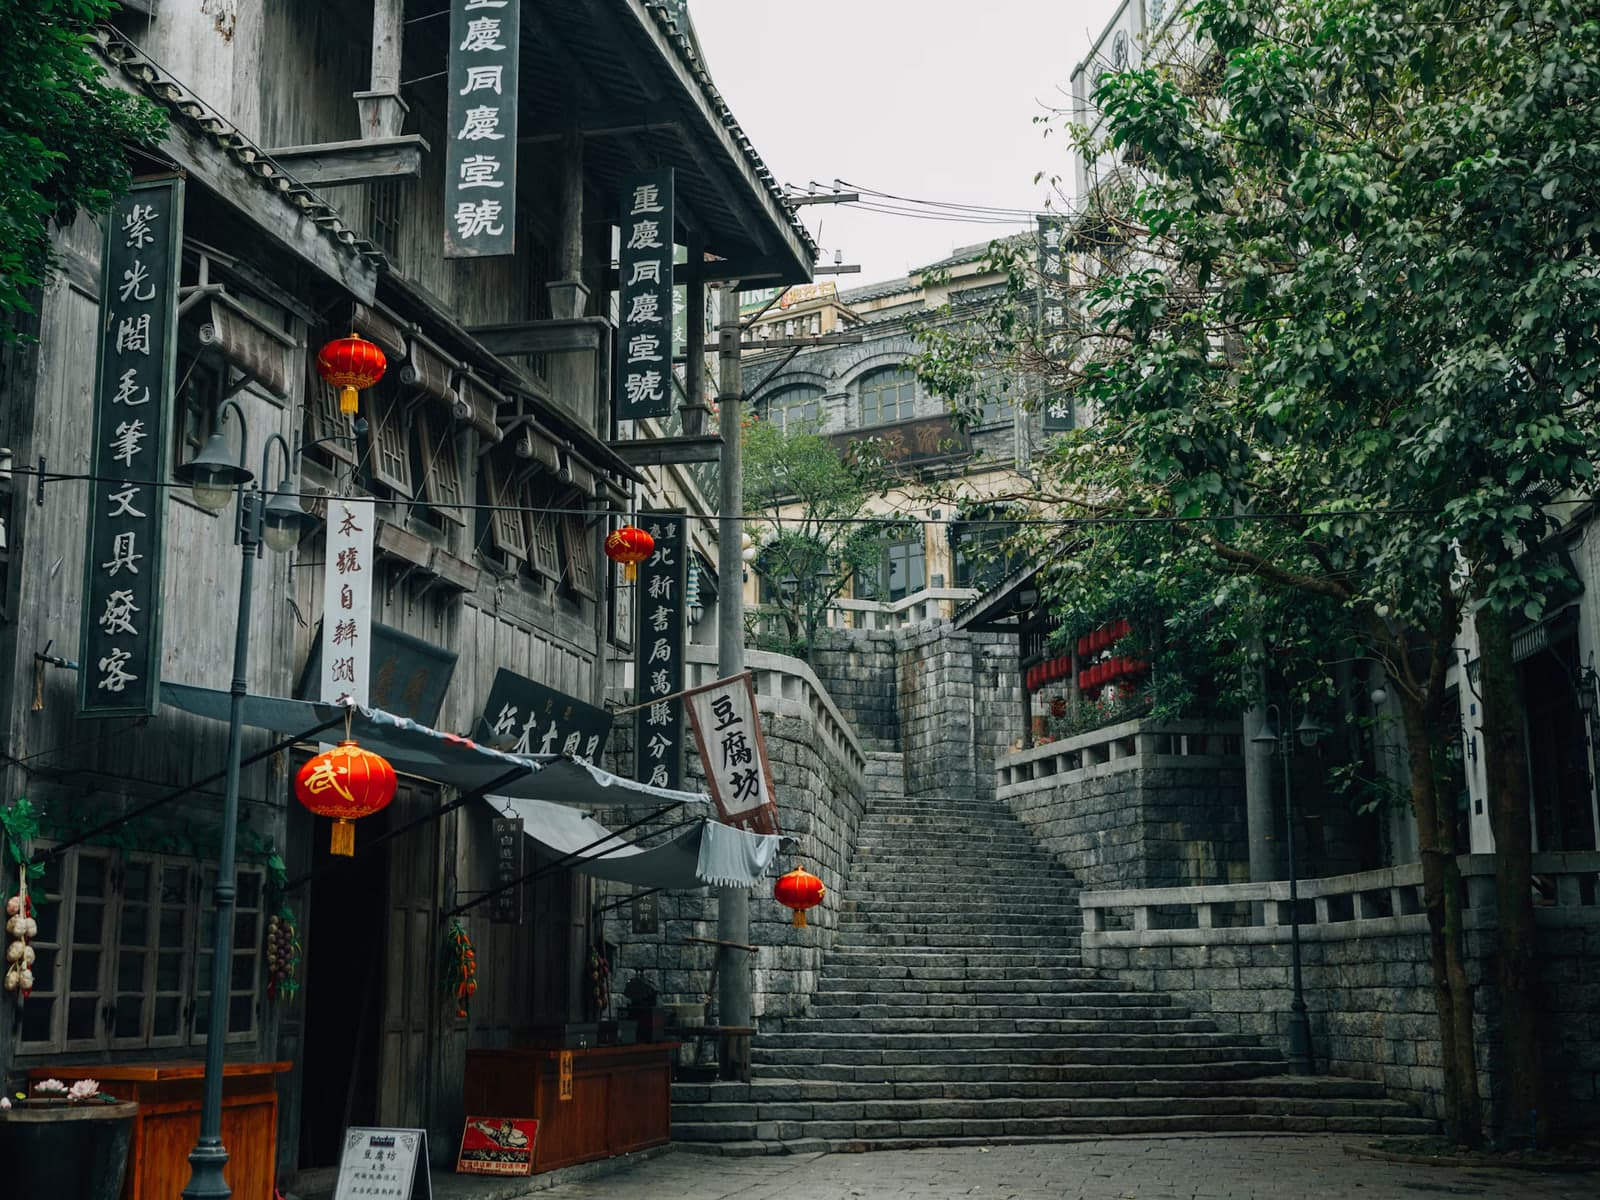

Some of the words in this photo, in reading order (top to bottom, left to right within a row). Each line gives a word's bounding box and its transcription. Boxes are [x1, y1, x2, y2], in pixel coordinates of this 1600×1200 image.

[625, 183, 664, 404] 重慶同慶堂號
[304, 758, 355, 802] 武
[711, 694, 760, 802] 豆腐坊
